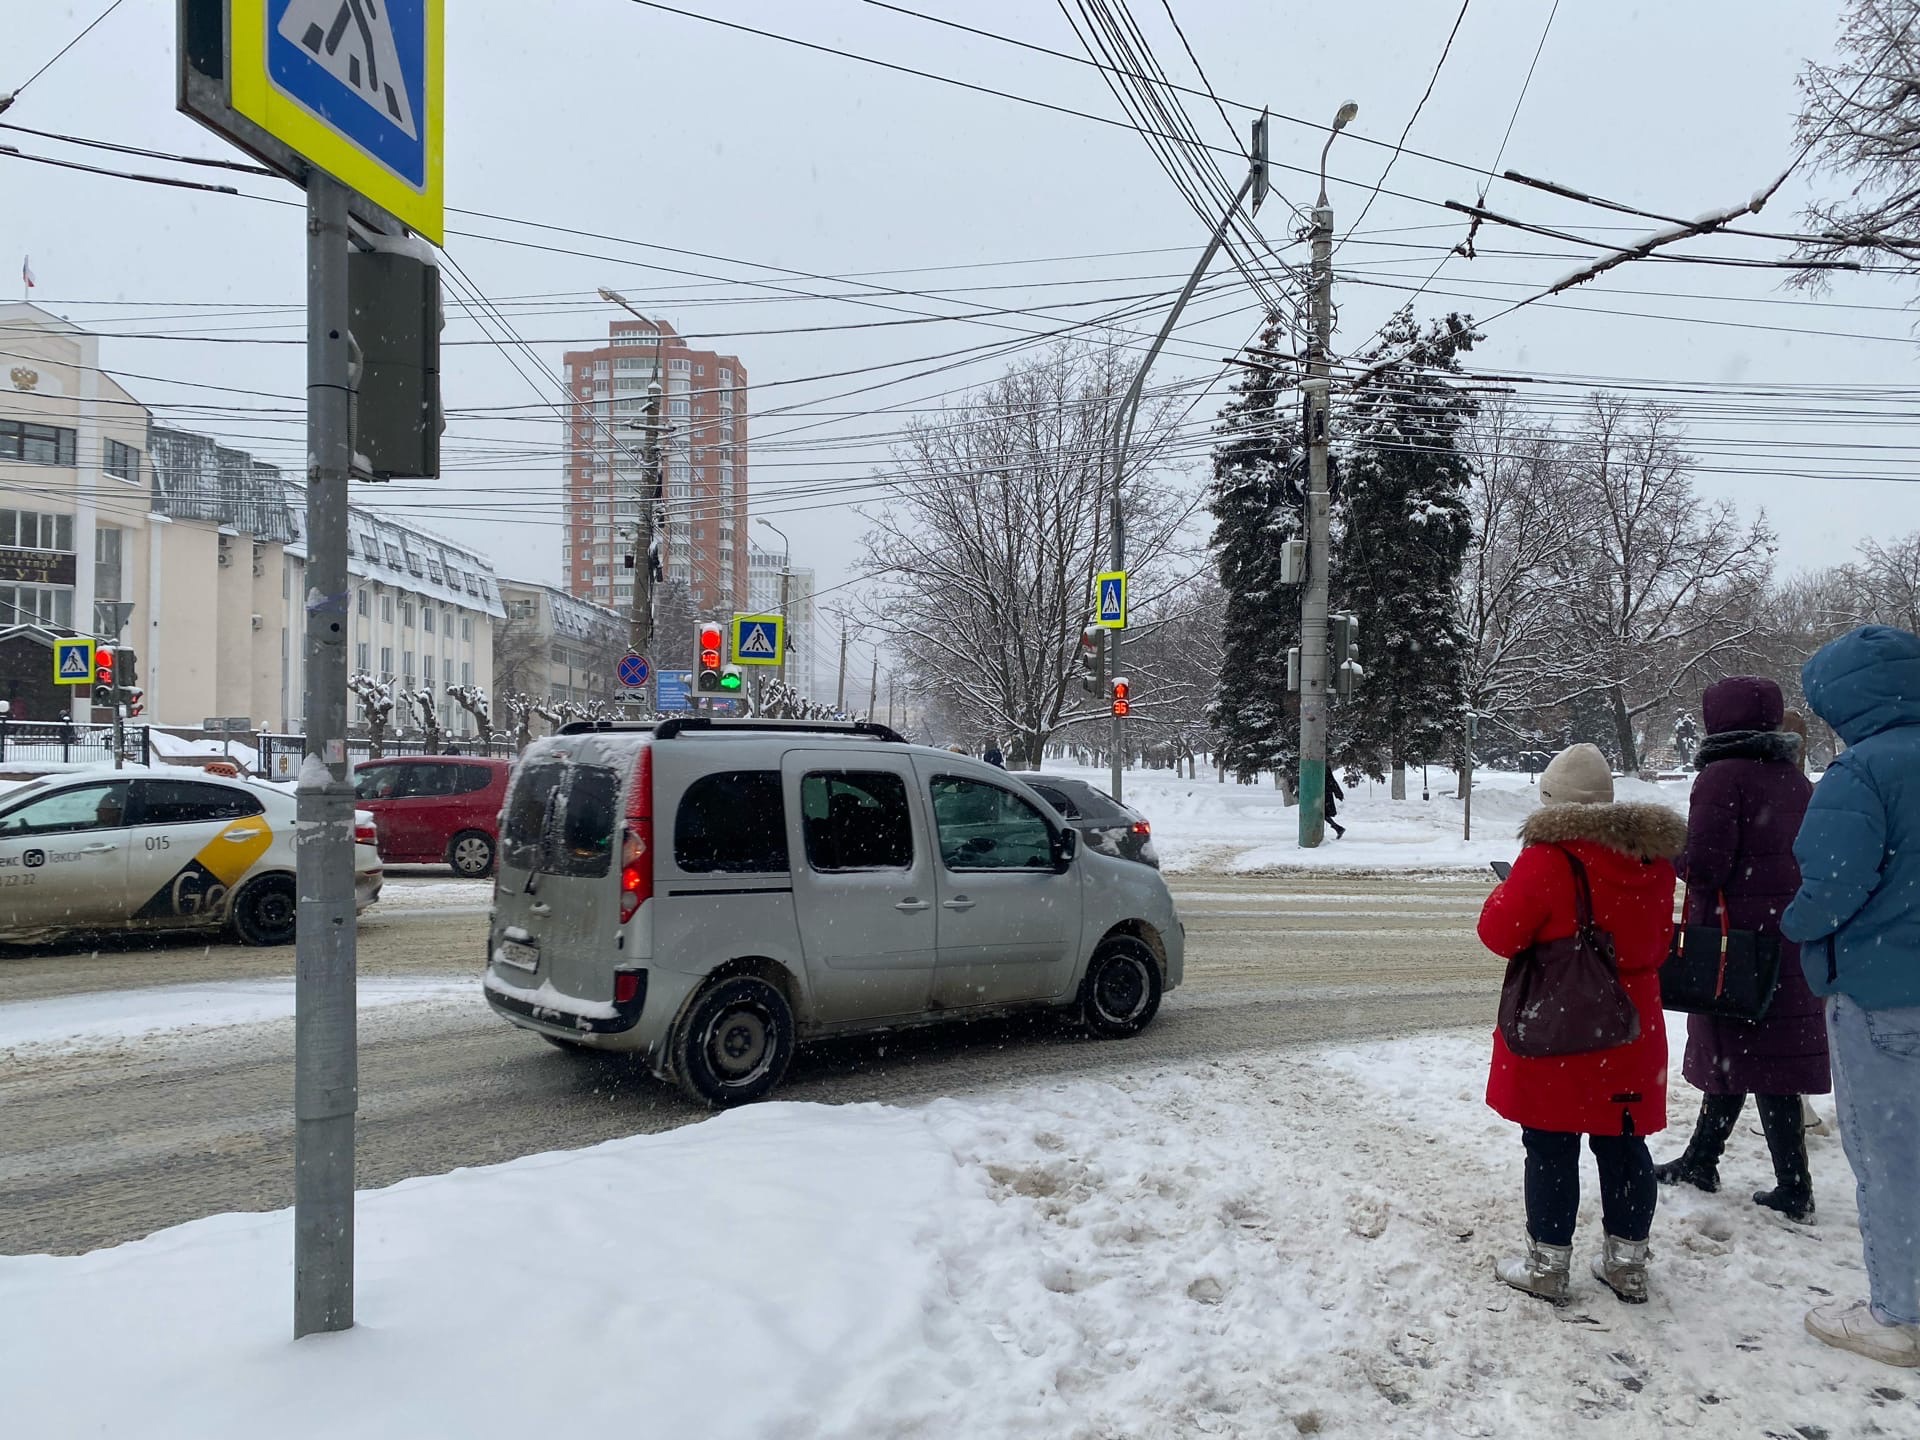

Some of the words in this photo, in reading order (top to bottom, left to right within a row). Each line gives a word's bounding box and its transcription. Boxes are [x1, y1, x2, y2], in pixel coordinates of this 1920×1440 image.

[1114, 702, 1127, 714] 35
[145, 836, 170, 850] 015
[26, 850, 42, 866] Go
[47, 849, 82, 863] Такси
